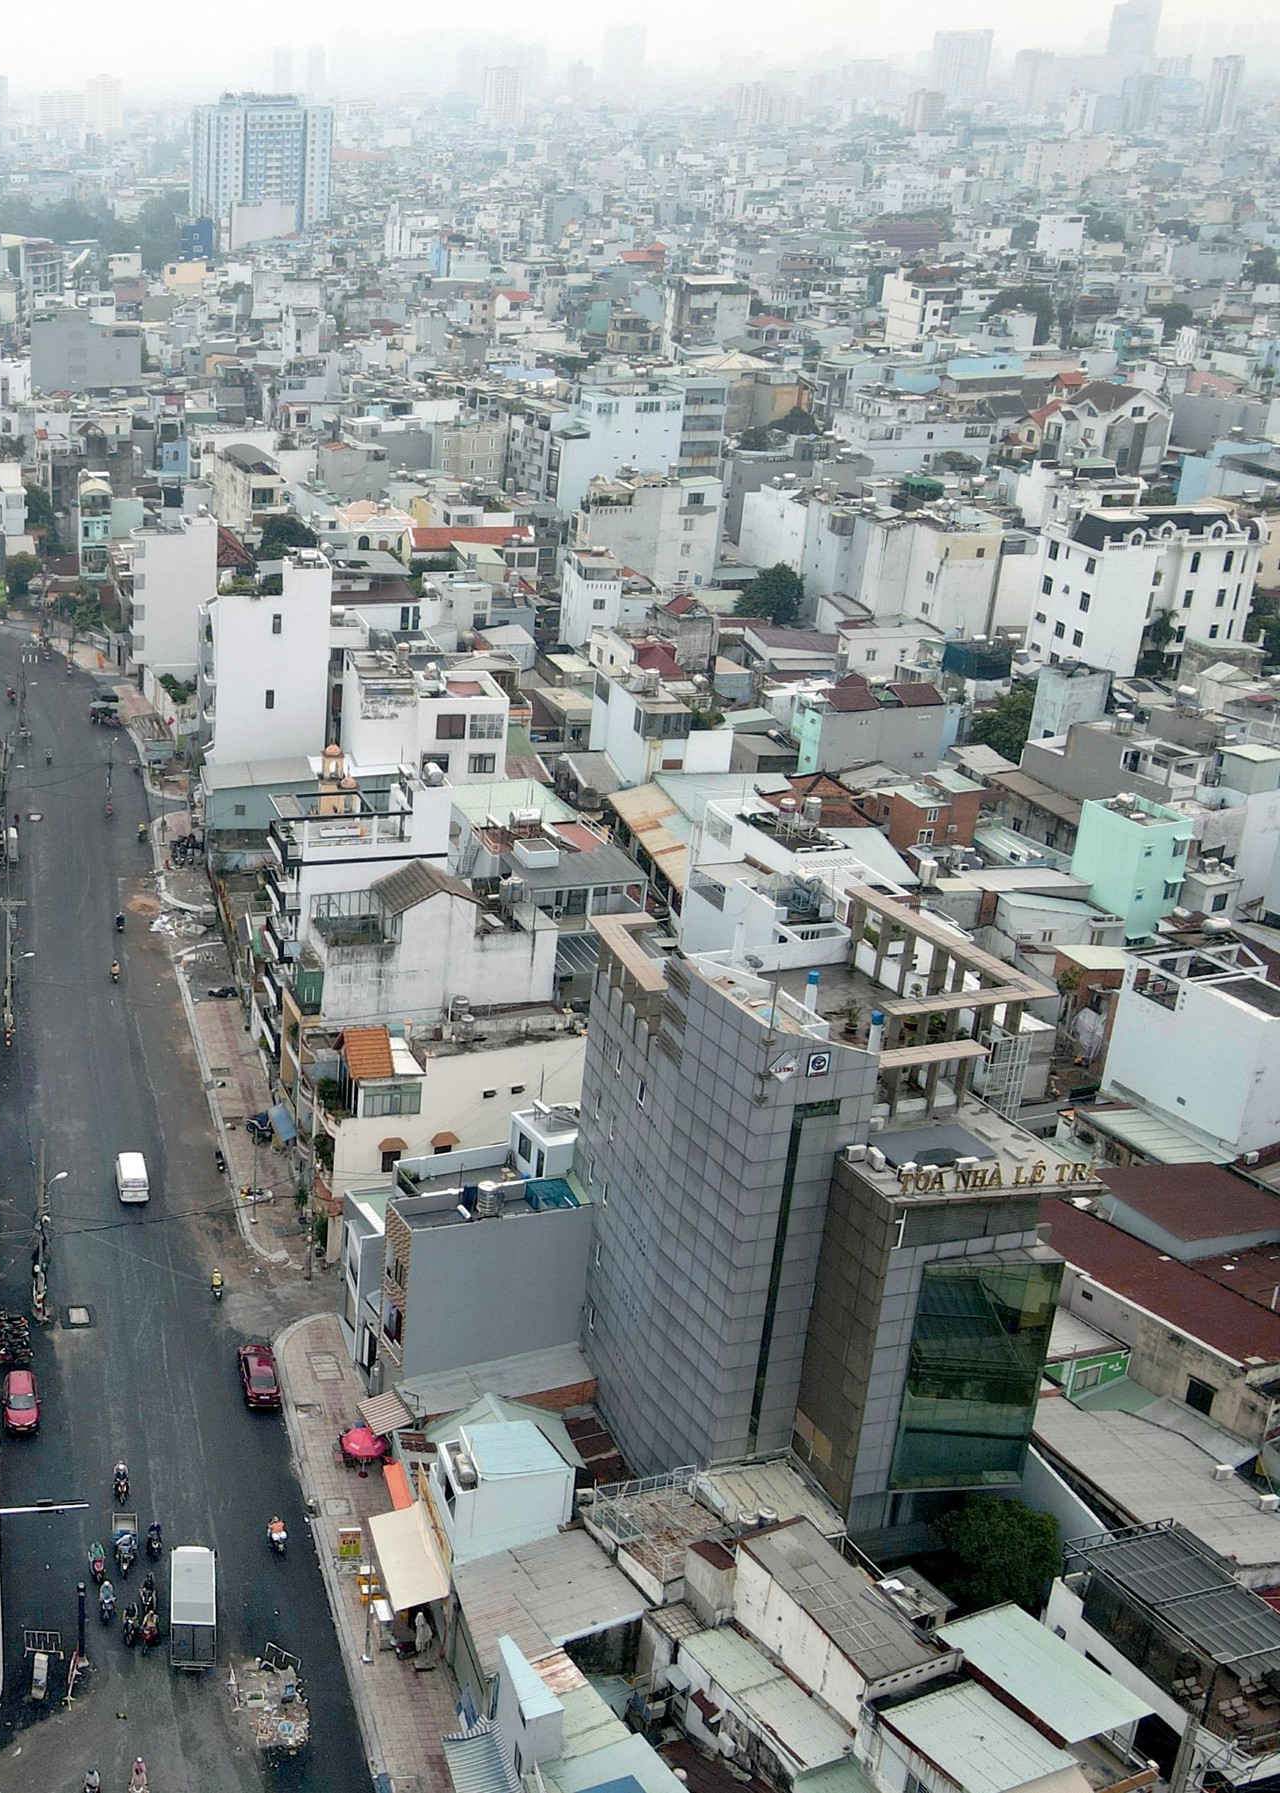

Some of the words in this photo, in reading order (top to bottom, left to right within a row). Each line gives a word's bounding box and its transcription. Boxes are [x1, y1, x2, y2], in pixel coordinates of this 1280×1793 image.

[953, 1161, 1003, 1190] NHÀ
[1012, 1160, 1047, 1185] LÊ
[1055, 1153, 1097, 1183] TRÍ
